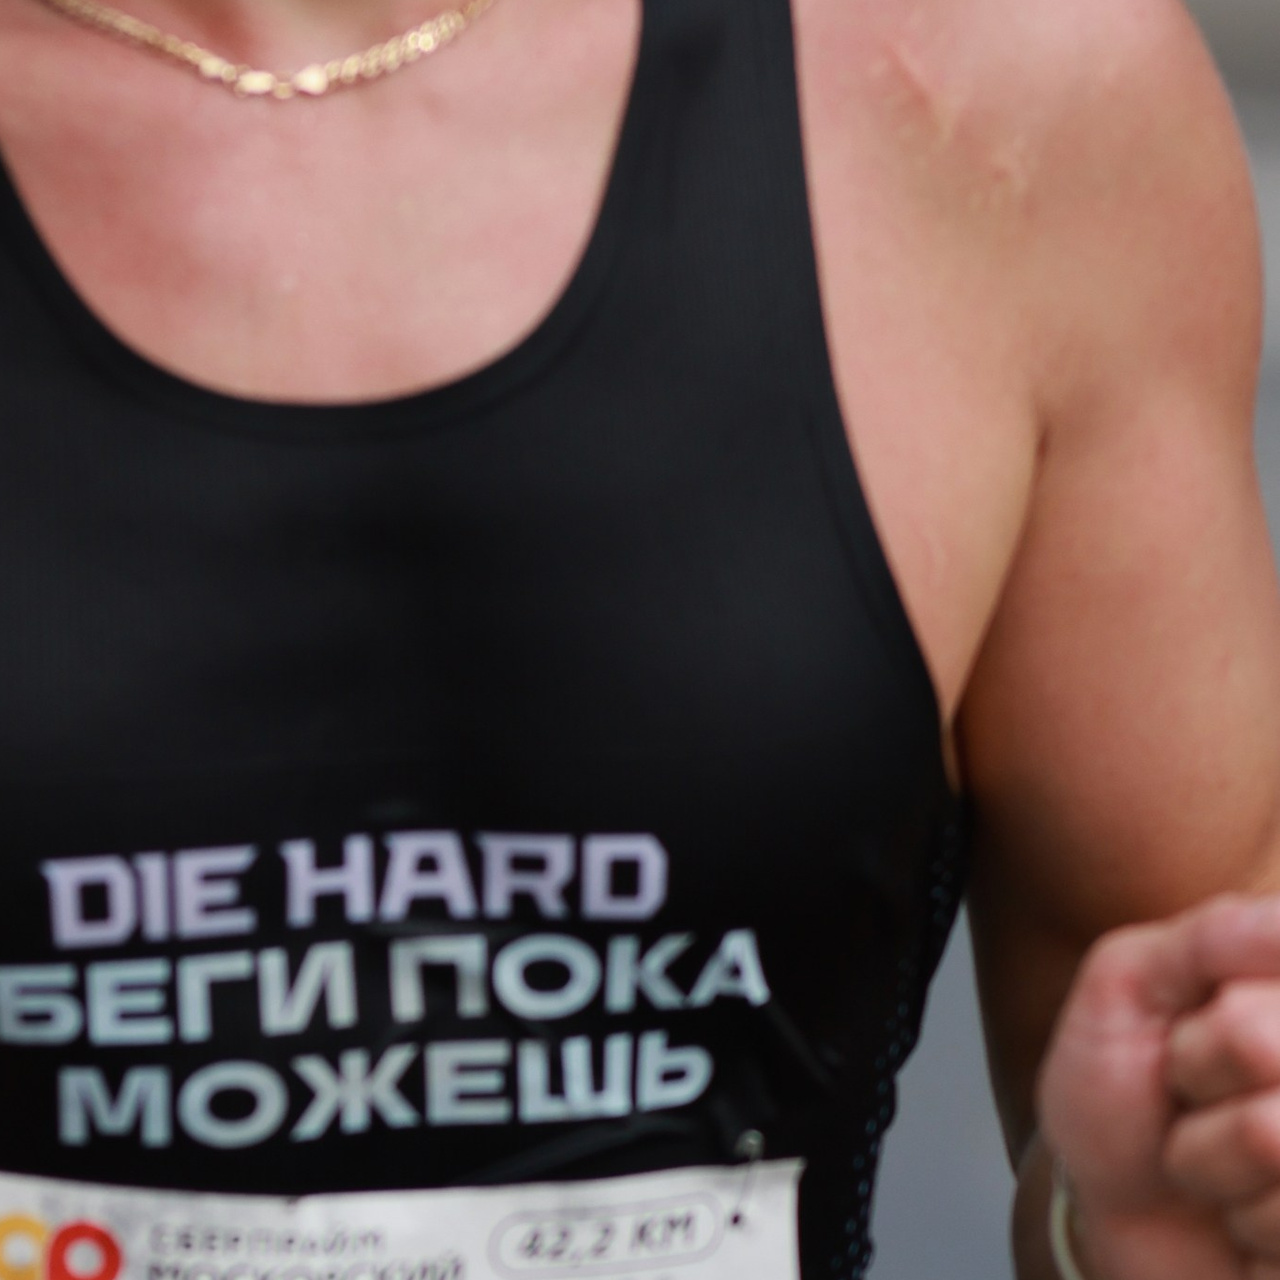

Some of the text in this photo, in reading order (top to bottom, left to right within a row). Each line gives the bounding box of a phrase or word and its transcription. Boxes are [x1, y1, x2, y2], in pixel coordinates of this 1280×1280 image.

[41, 830, 669, 949] DIE HARD
[389, 929, 770, 1023] ПОКА
[57, 1030, 715, 1148] МОЖЕШЬ
[518, 1208, 698, 1268] 42,2 КМ
